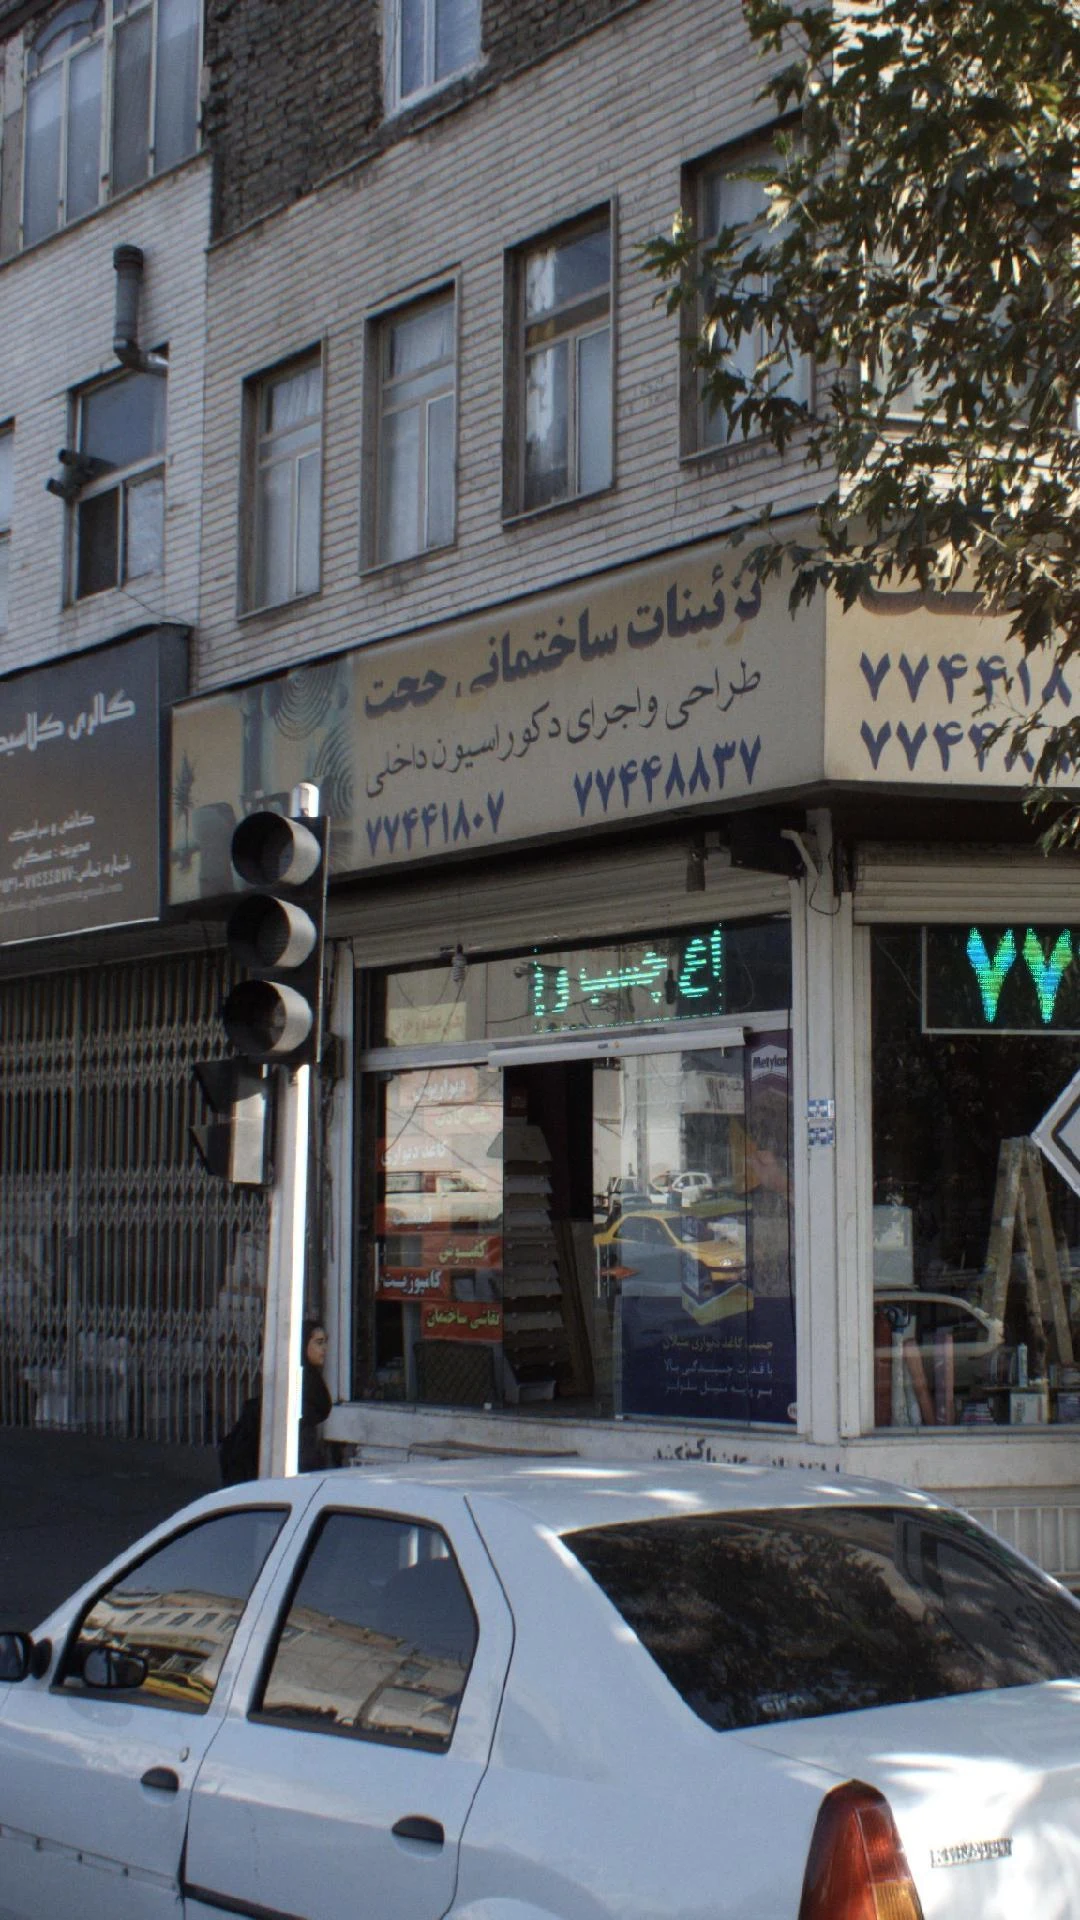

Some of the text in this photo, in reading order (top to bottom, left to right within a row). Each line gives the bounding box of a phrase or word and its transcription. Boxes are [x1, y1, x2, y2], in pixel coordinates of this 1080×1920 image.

[455, 606, 618, 694] ساختمانی
[665, 657, 761, 730] طراحی
[366, 743, 428, 798] داخلی
[431, 700, 561, 774] دکوراسیون
[573, 735, 762, 818] ۷۷۴۴۸۸۳۷
[366, 791, 505, 857] ۷۷۴۴۱۸۰۷
